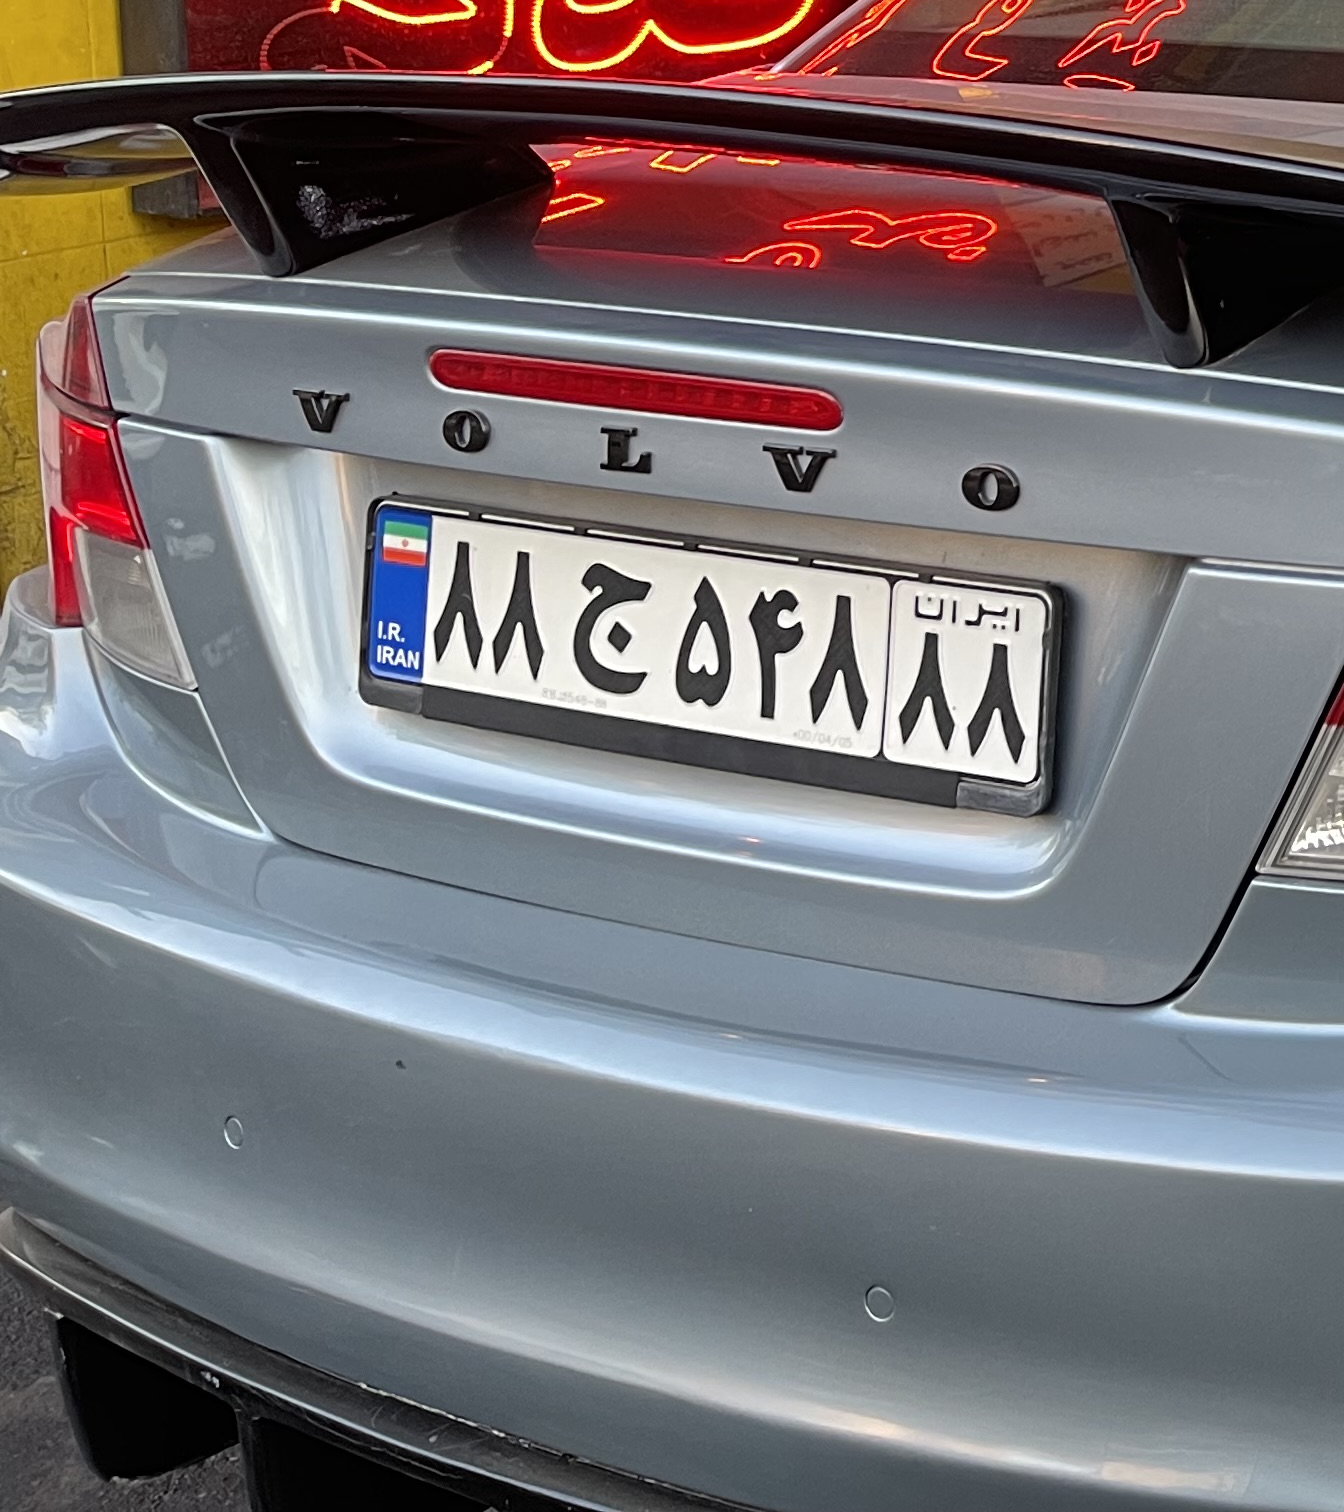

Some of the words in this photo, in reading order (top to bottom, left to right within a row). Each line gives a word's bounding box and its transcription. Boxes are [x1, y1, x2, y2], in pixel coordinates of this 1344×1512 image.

[293, 389, 1021, 512] VOLVO
[914, 595, 1021, 632] ایران
[377, 620, 405, 643] I.R.
[376, 645, 421, 670] IRAN
